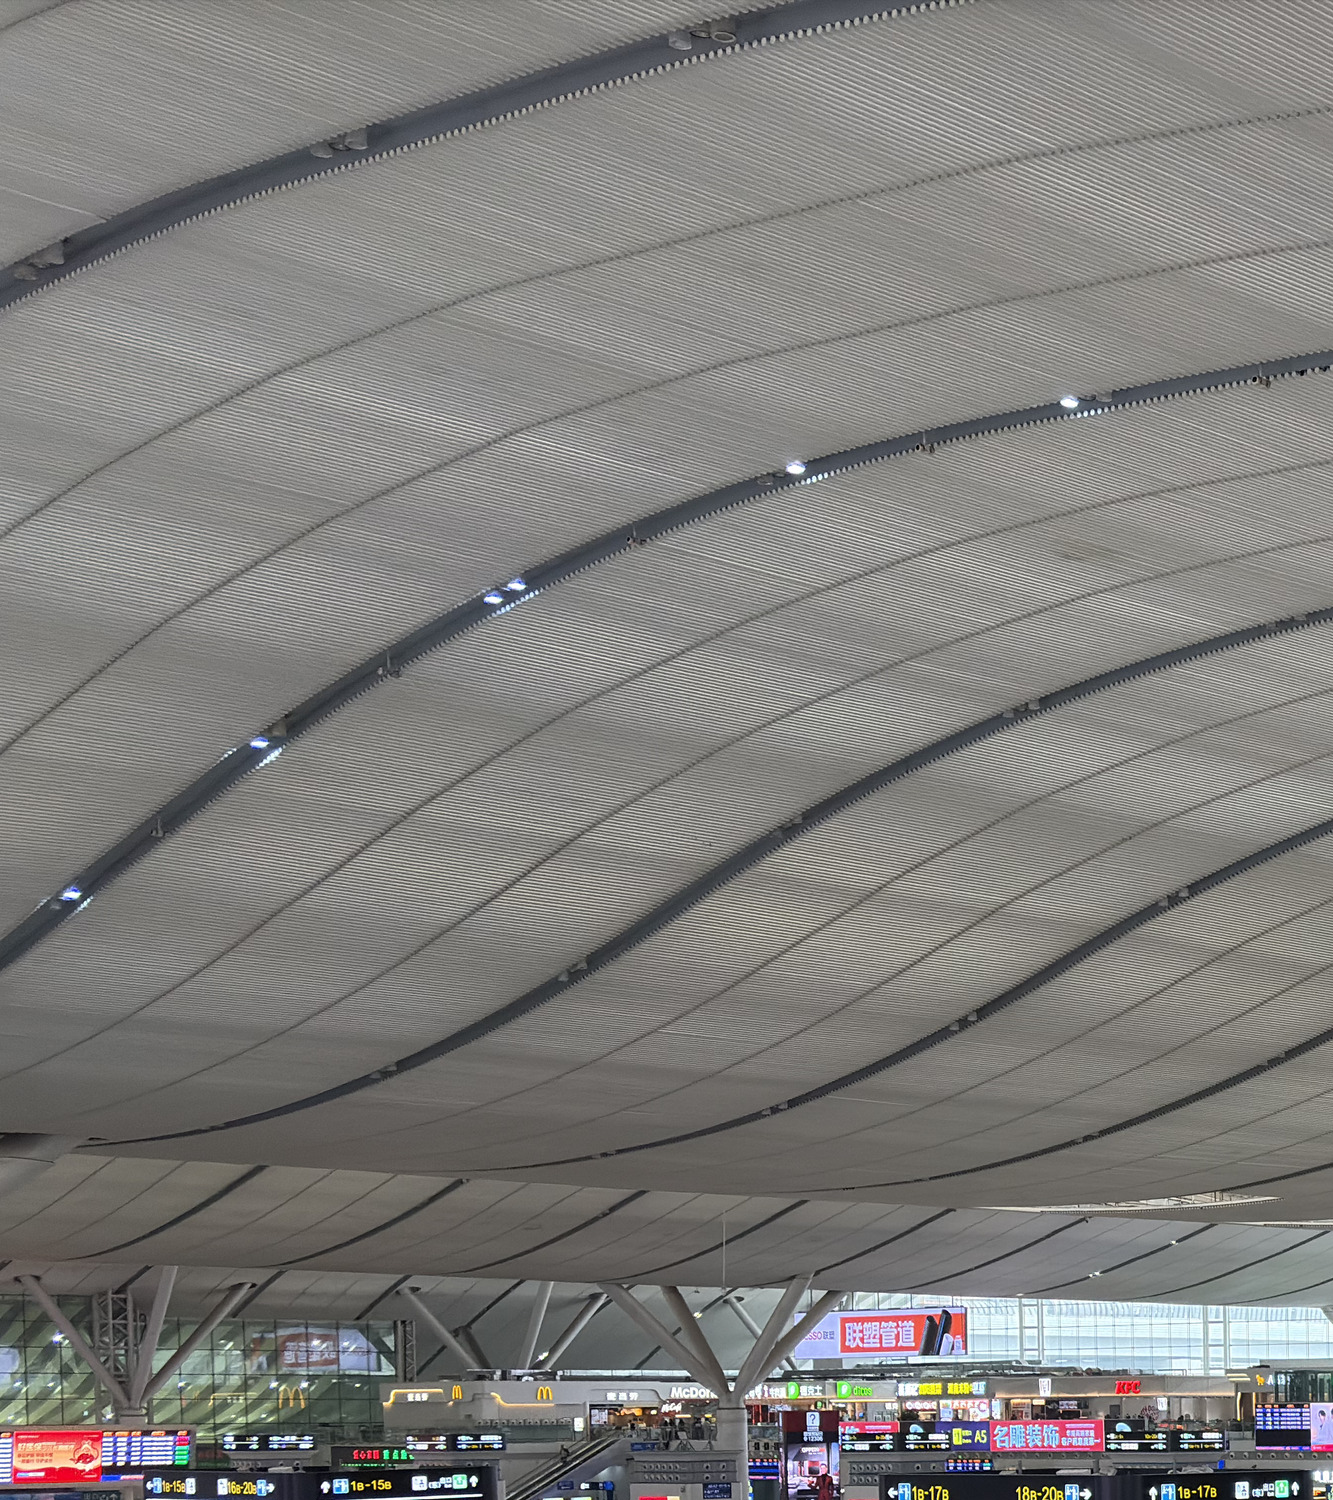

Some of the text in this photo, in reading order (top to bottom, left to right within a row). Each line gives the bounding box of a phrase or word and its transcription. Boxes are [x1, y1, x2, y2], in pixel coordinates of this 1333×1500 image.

[845, 1320, 916, 1349] 联塑管道
[853, 1384, 873, 1397] dicos
[1115, 1380, 1141, 1395] KFC
[974, 1429, 988, 1444] A5
[993, 1425, 1061, 1449] 名雕装饰
[351, 1479, 392, 1492] 1B-15B
[1177, 1485, 1218, 1500] 1B-17B
